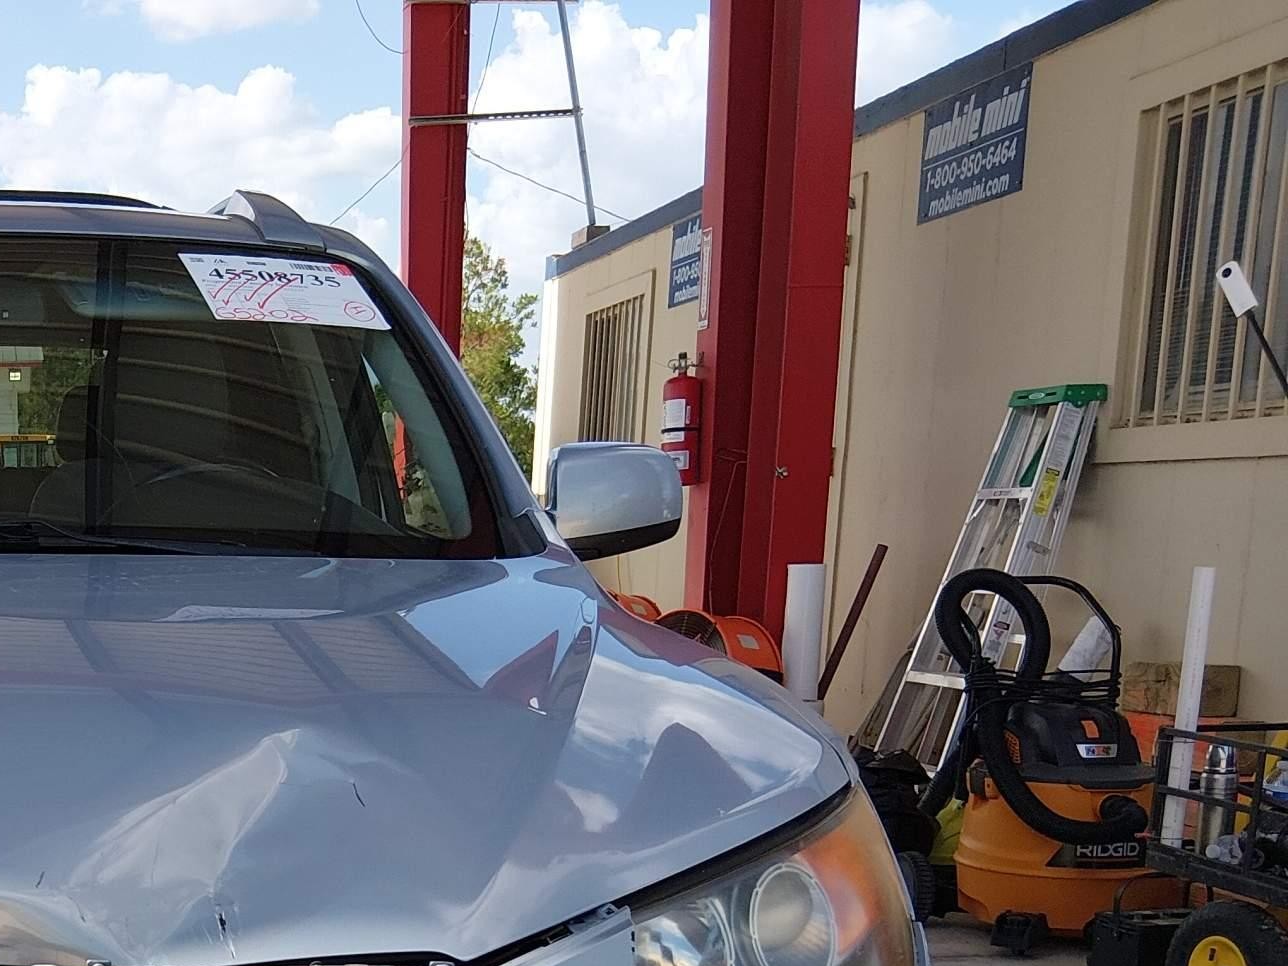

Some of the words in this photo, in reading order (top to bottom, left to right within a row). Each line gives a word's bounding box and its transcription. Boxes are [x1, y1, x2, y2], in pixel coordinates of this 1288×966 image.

[925, 93, 981, 160] mobile
[981, 79, 1026, 137] mini
[926, 137, 1018, 193] 1-800-950-6464
[928, 174, 1010, 217] mobilemini.com
[208, 267, 342, 289] 45508735
[1076, 842, 1140, 857] RIDGID
